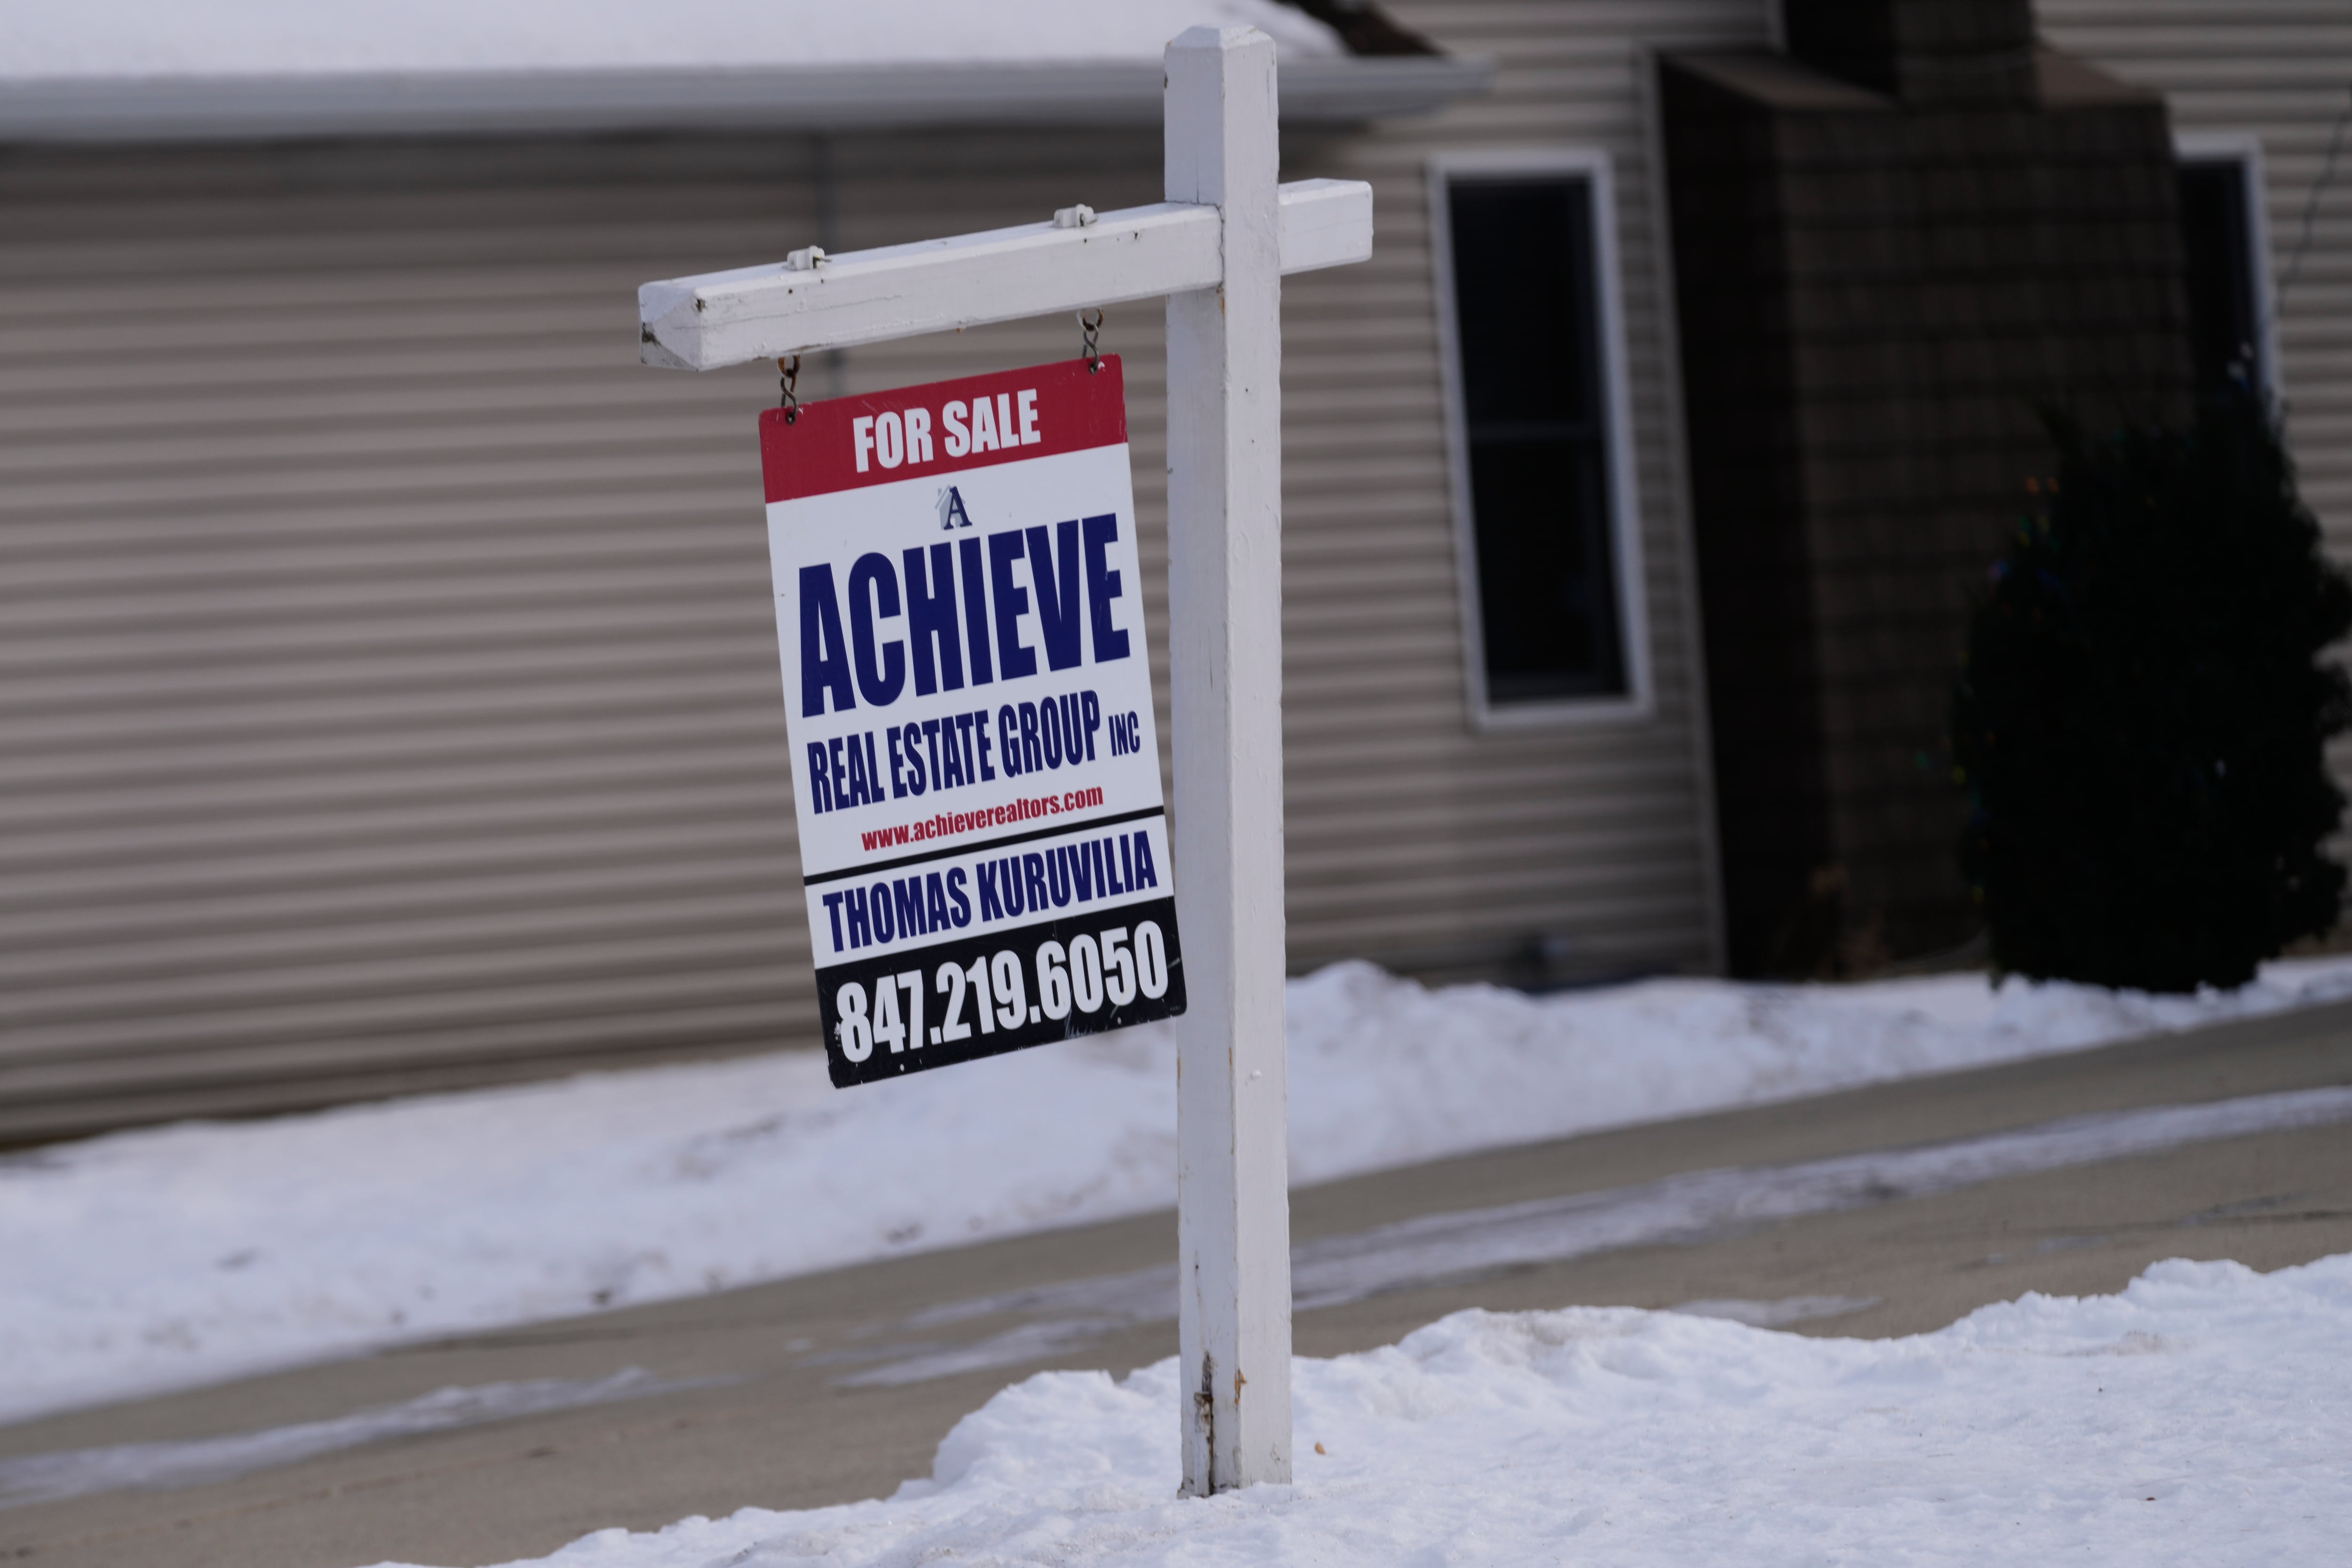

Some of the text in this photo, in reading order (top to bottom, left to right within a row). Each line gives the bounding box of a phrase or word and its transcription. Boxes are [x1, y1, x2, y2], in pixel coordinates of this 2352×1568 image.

[853, 389, 1041, 472] FOR SALE
[944, 485, 972, 530] A
[799, 512, 1130, 718] ACHIEVE
[807, 690, 1140, 814] REAL ESTATE GROUP INC
[861, 787, 1104, 851] www.achieverealtors.com
[822, 830, 1158, 953] THOMAS KURUVILIA
[836, 920, 1169, 1063] 847.219.6050
